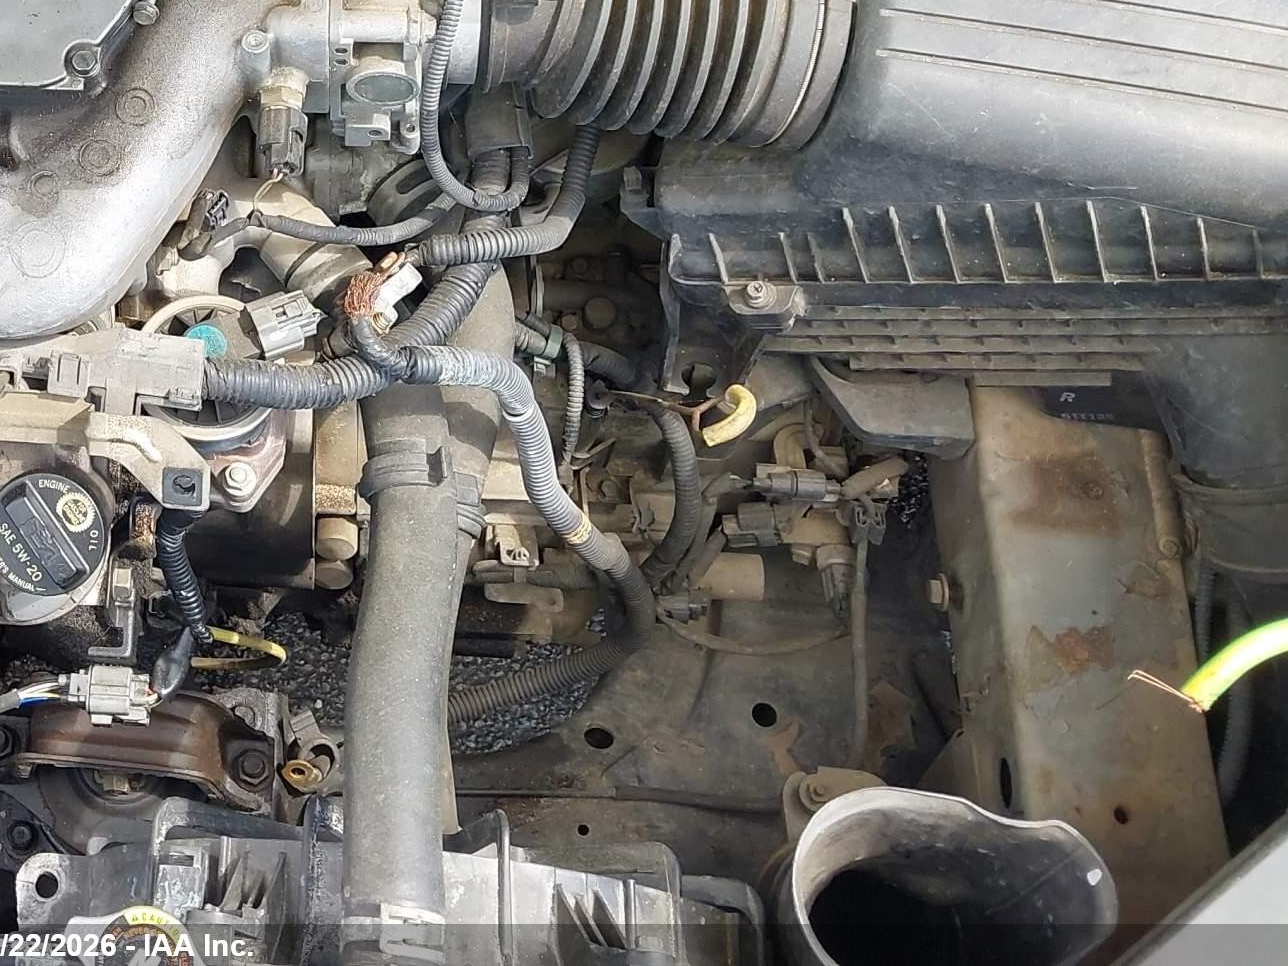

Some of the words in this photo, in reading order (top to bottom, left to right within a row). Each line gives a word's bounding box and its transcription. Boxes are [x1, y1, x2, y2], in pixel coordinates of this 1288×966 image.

[38, 479, 70, 494] ENGINE
[89, 530, 99, 551] OIL
[12, 543, 42, 581] 5W-20
[7, 572, 35, 591] MANUAL
